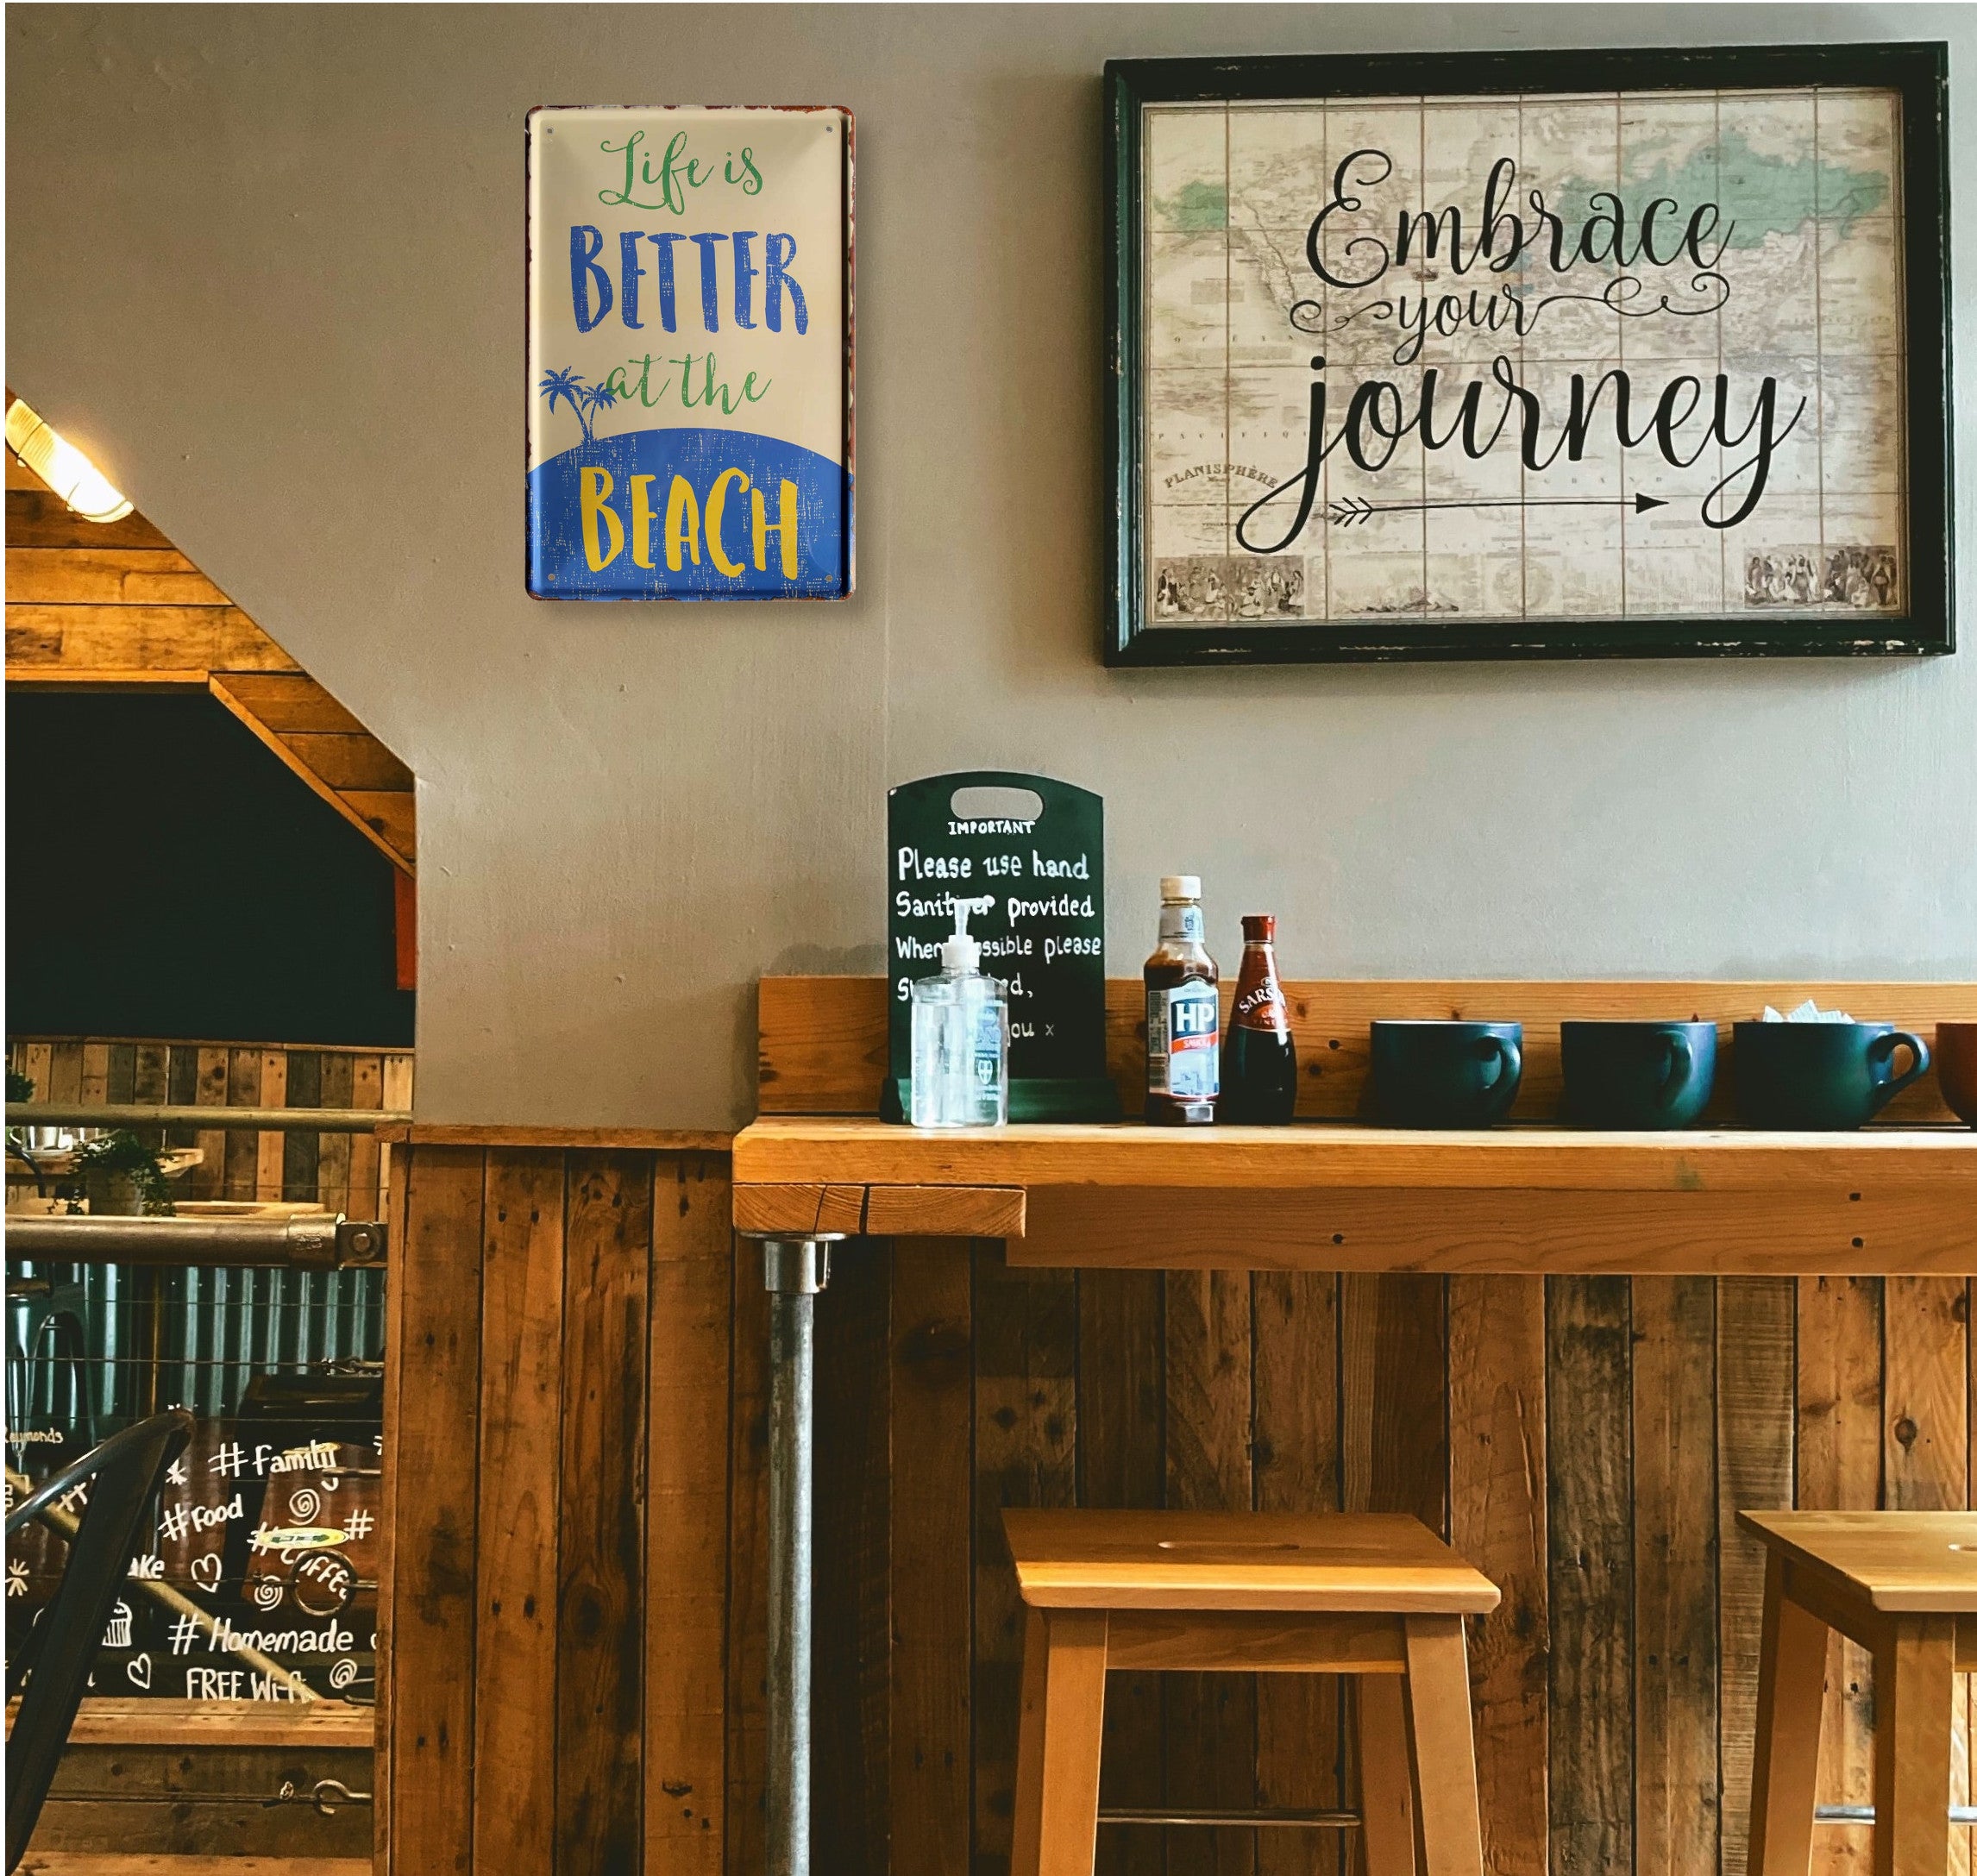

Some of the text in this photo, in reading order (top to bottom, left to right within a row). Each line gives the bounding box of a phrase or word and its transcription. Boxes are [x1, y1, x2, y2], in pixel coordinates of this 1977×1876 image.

[598, 130, 763, 215] Life is
[1306, 148, 1735, 288] Embrace
[569, 225, 809, 336] BETTER
[606, 352, 772, 415] at the
[1235, 355, 1807, 553] journey
[580, 467, 799, 580] BEACH
[948, 820, 1035, 835] IMPORTANT
[898, 847, 1090, 881] Please use hand
[895, 891, 1095, 927] Saniter provided
[977, 935, 1032, 957] ssible
[1045, 936, 1102, 964] please
[1176, 1002, 1215, 1033] HP
[186, 1666, 245, 1702] FREE
